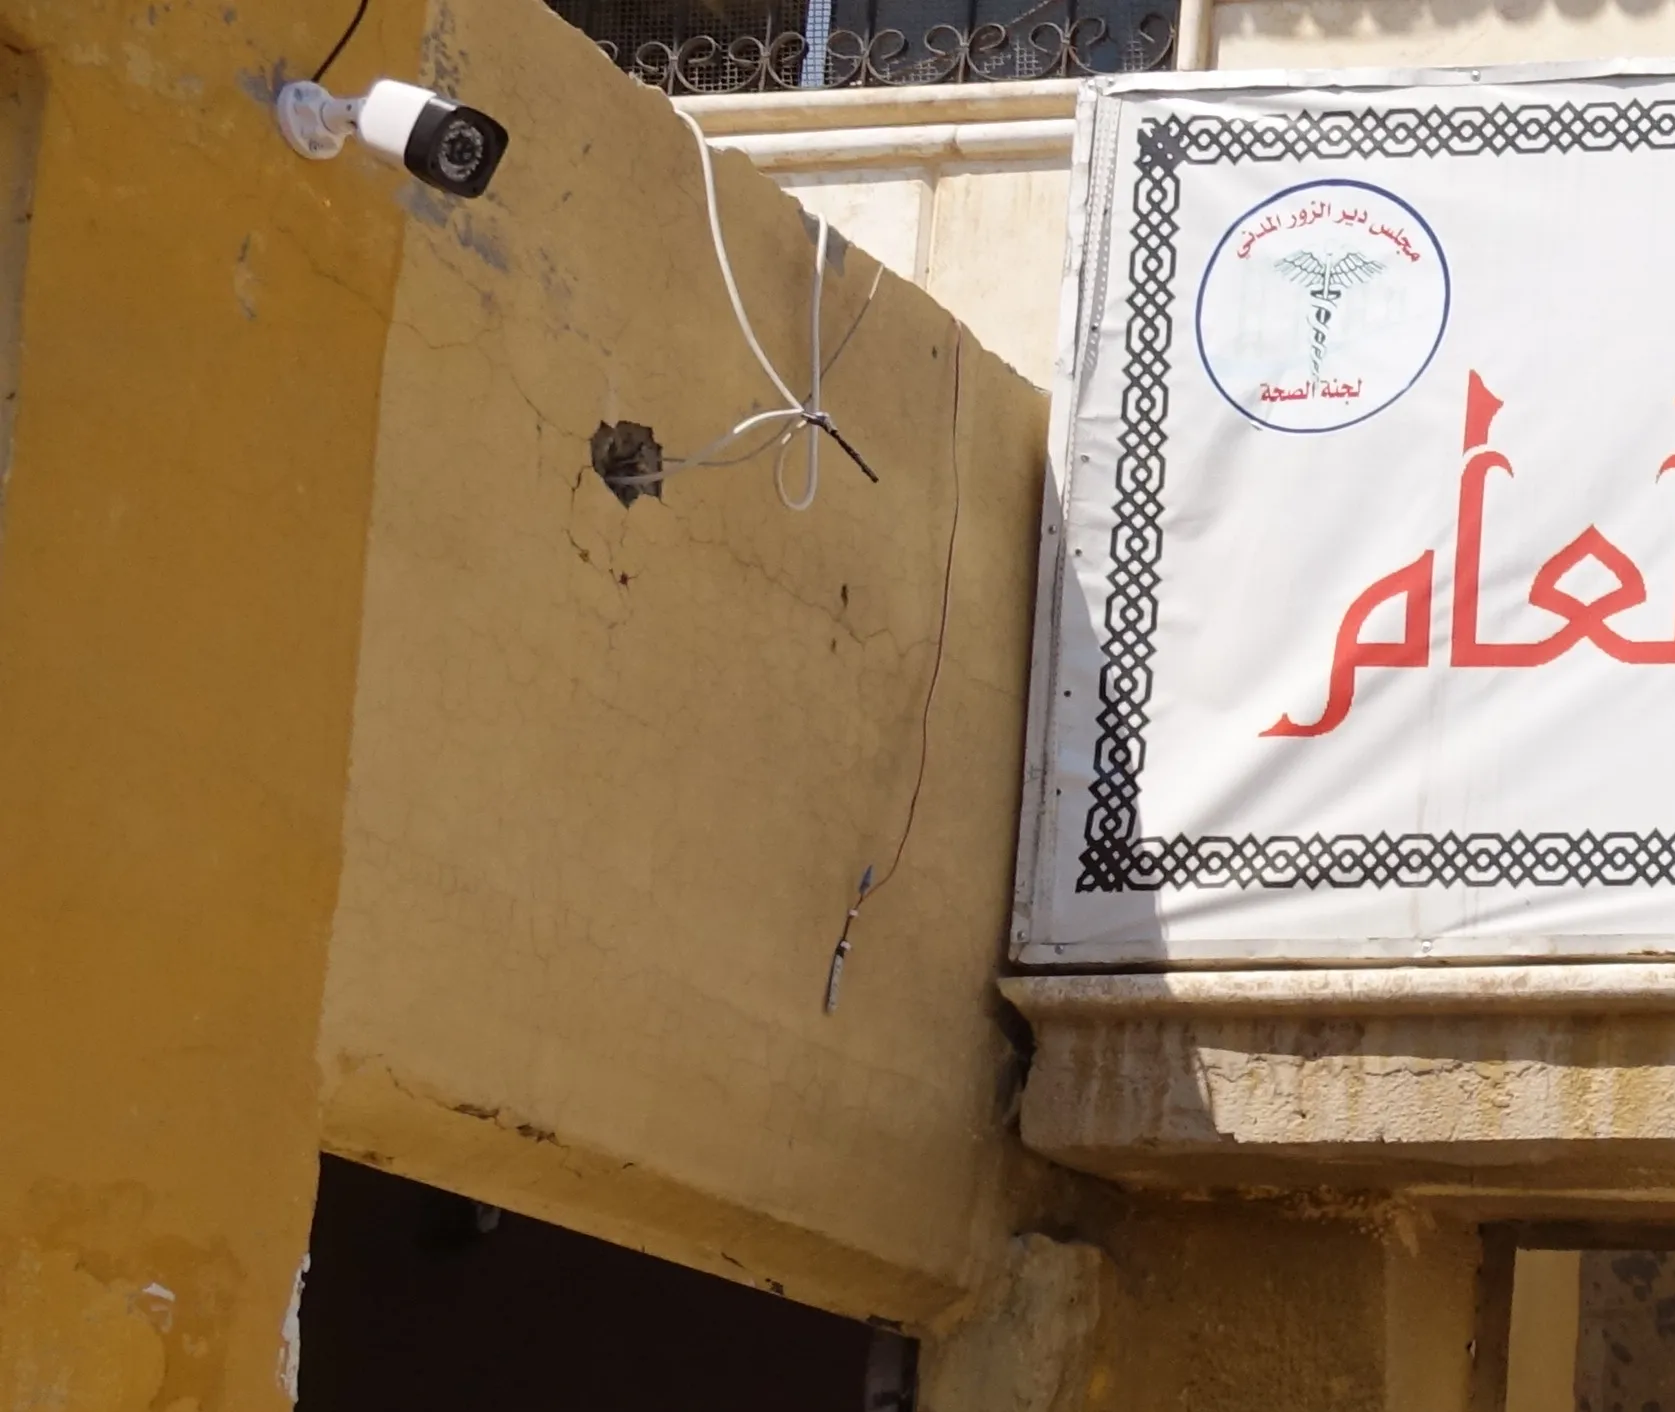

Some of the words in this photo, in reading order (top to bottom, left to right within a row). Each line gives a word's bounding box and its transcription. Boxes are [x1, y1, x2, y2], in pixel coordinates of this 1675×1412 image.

[1286, 200, 1332, 229] الزور
[1332, 208, 1368, 226] دير
[1237, 214, 1282, 260] المدني
[1368, 221, 1421, 262] مجلس
[1260, 380, 1316, 402] الصحة
[1320, 378, 1362, 405] لجنة
